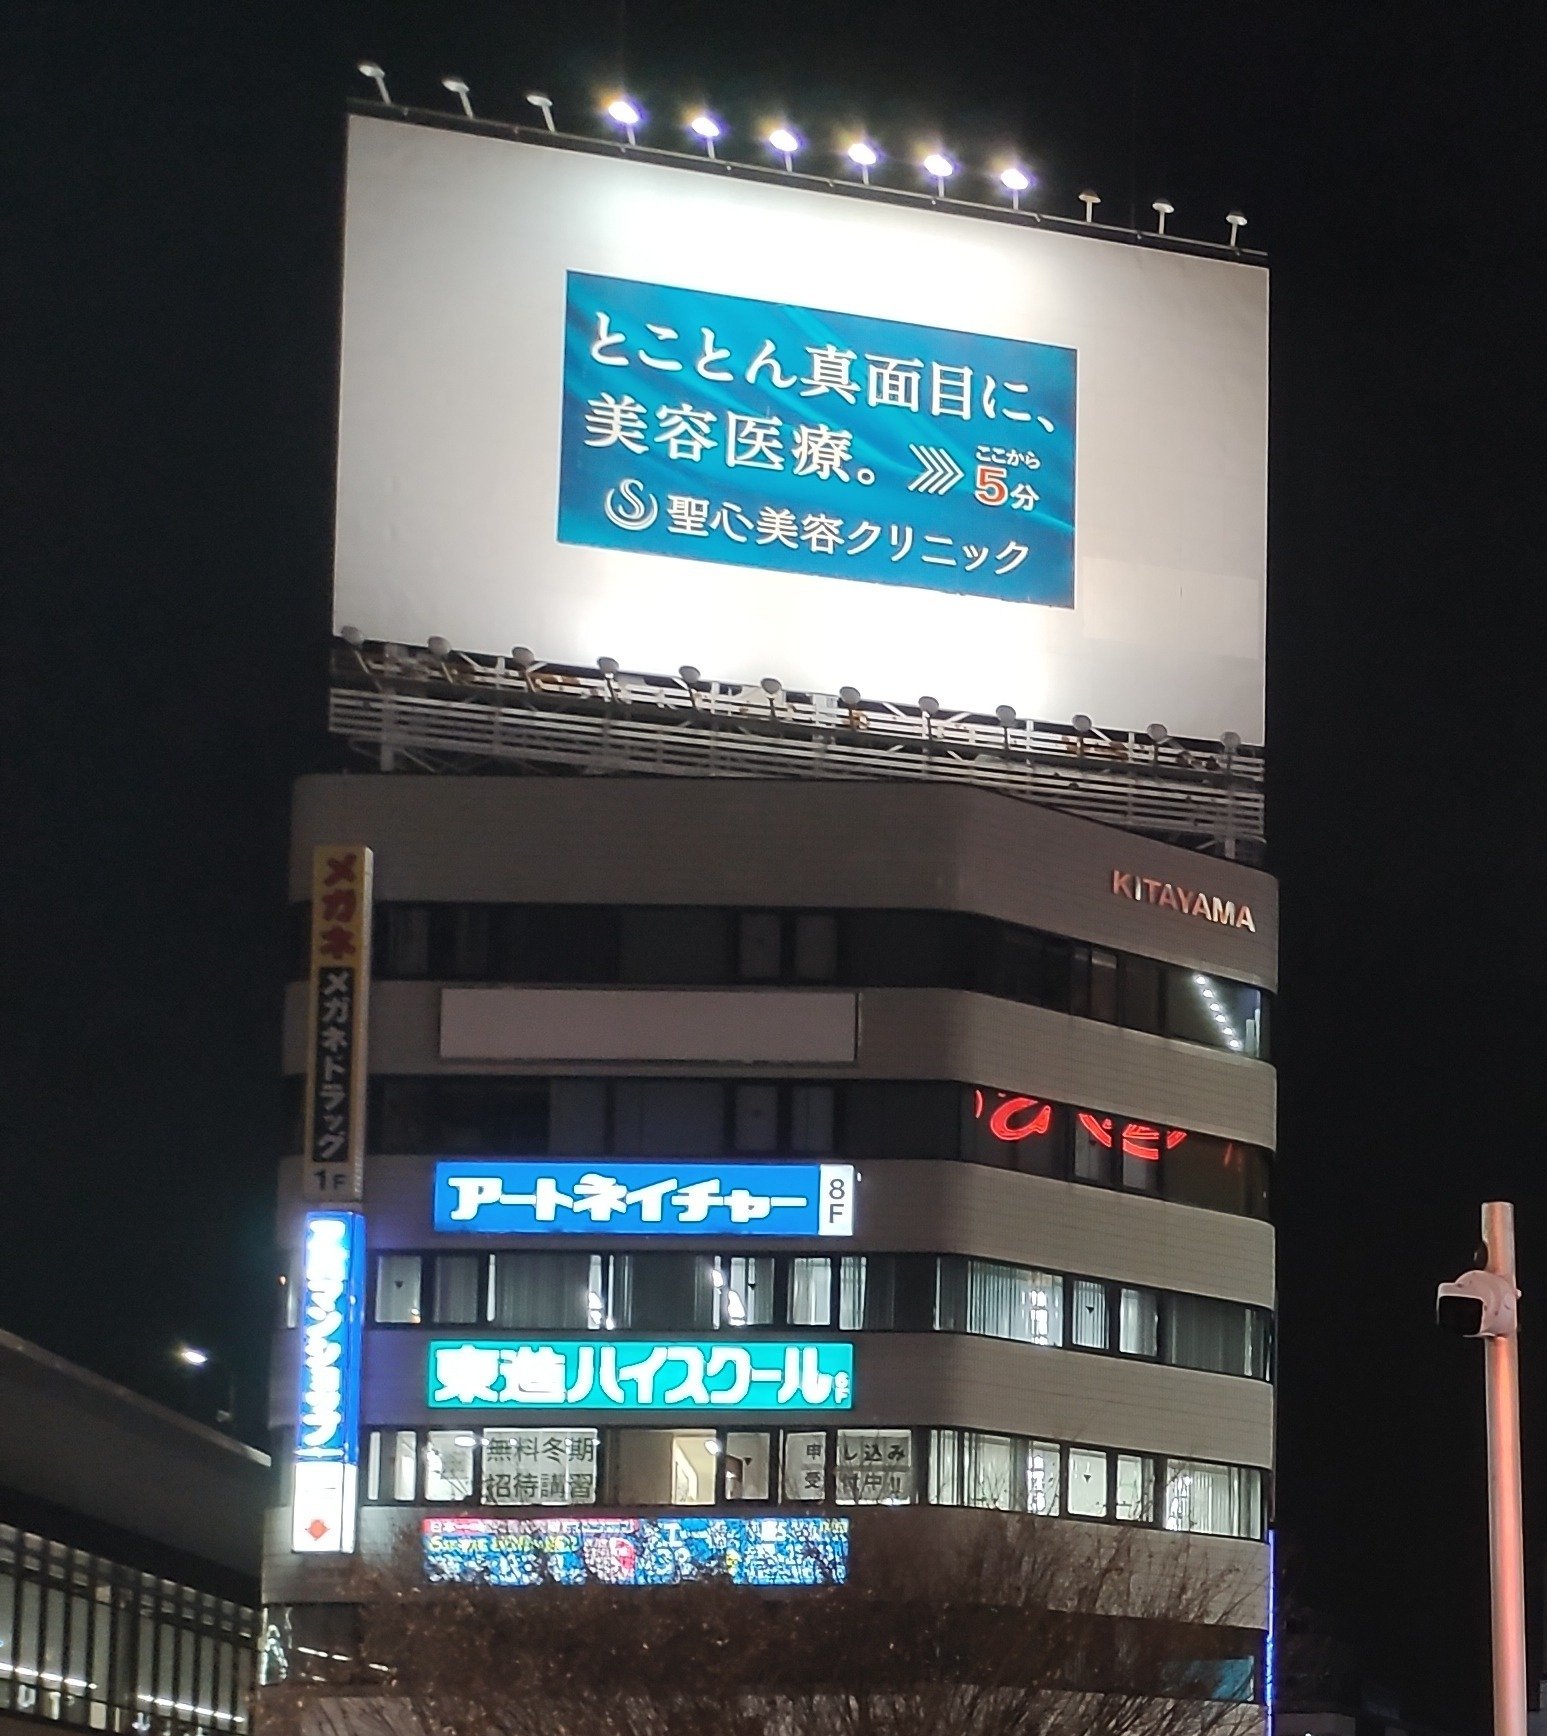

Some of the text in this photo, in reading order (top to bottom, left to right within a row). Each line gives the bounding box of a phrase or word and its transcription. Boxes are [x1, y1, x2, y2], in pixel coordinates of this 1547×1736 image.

[587, 311, 1057, 434] とことん真面目に、
[583, 391, 877, 487] 美容医療。
[975, 444, 1041, 470] ここから
[973, 466, 1040, 513] 5分
[666, 494, 1030, 576] 聖心美容クリニック
[319, 852, 356, 960] メガネ
[1113, 869, 1256, 932] KITAYAMA
[313, 1170, 345, 1190] 1F
[448, 1173, 806, 1222] アートネイチャー
[829, 1178, 845, 1224] 8F
[435, 1345, 833, 1404] 東進ハイスクール
[485, 1437, 594, 1463] 無料冬期
[485, 1471, 593, 1499] 招待講習
